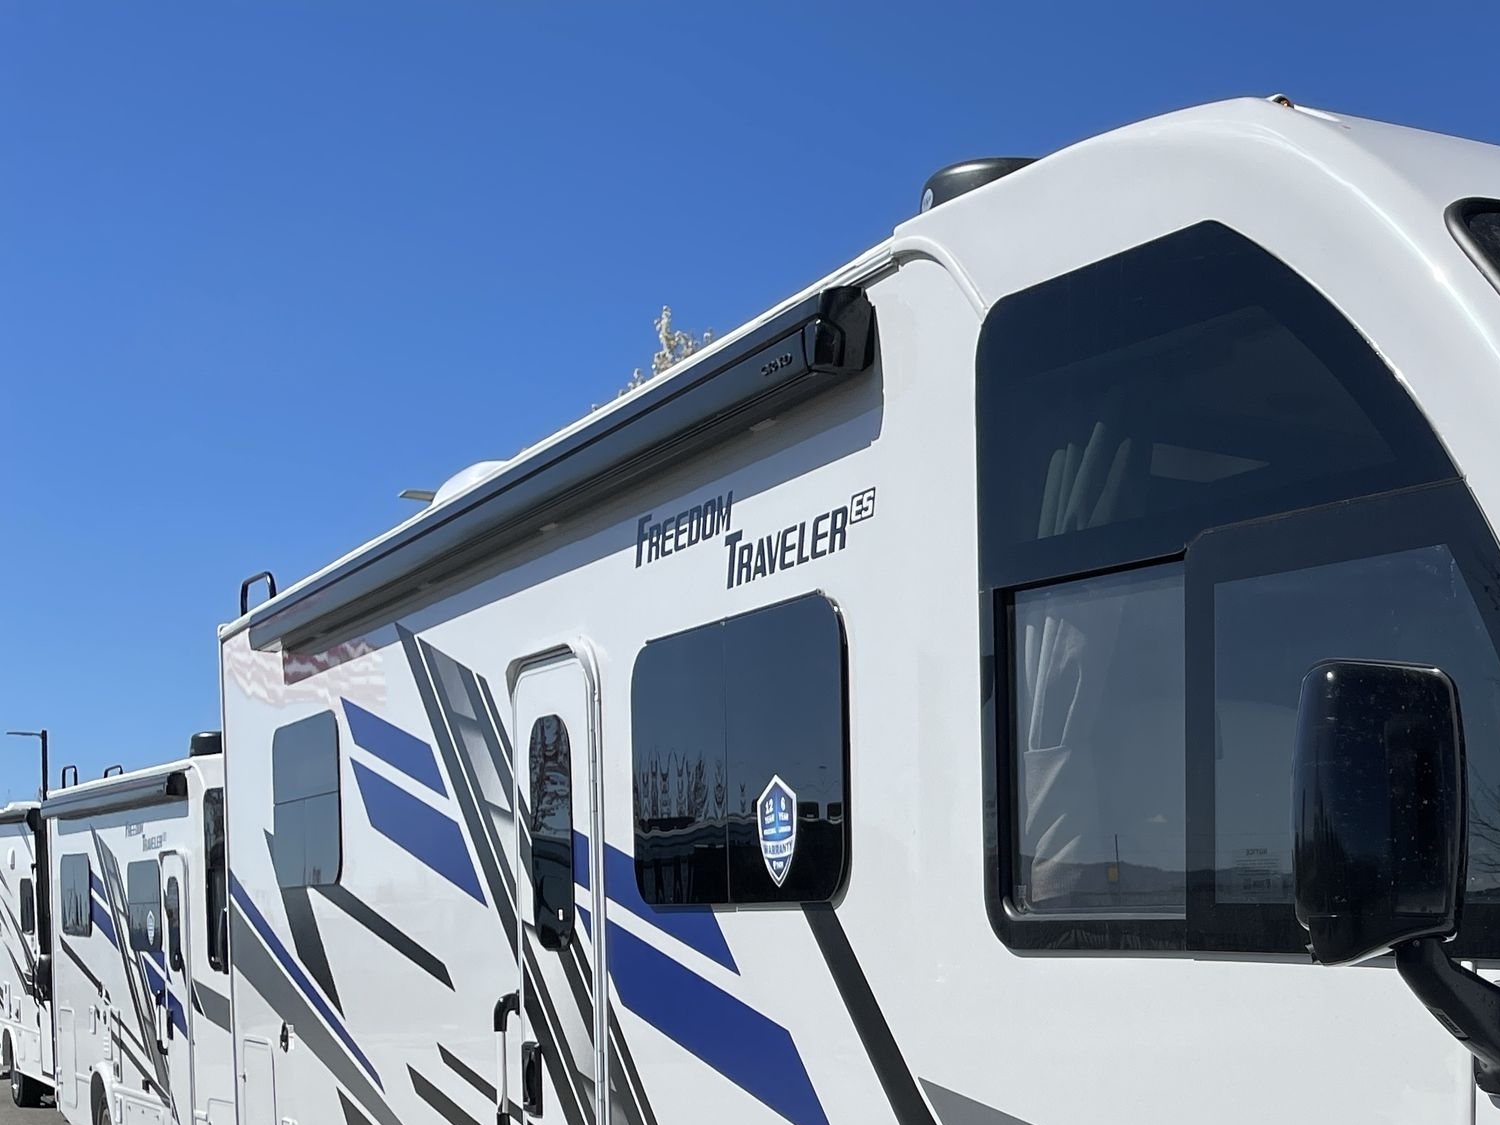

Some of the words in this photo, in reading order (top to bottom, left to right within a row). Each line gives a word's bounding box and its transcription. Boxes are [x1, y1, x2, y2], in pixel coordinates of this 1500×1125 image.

[635, 491, 733, 568] FREEDOM
[725, 505, 847, 589] TRAVELER
[852, 490, 875, 523] ES
[763, 842, 793, 856] WARRANTY
